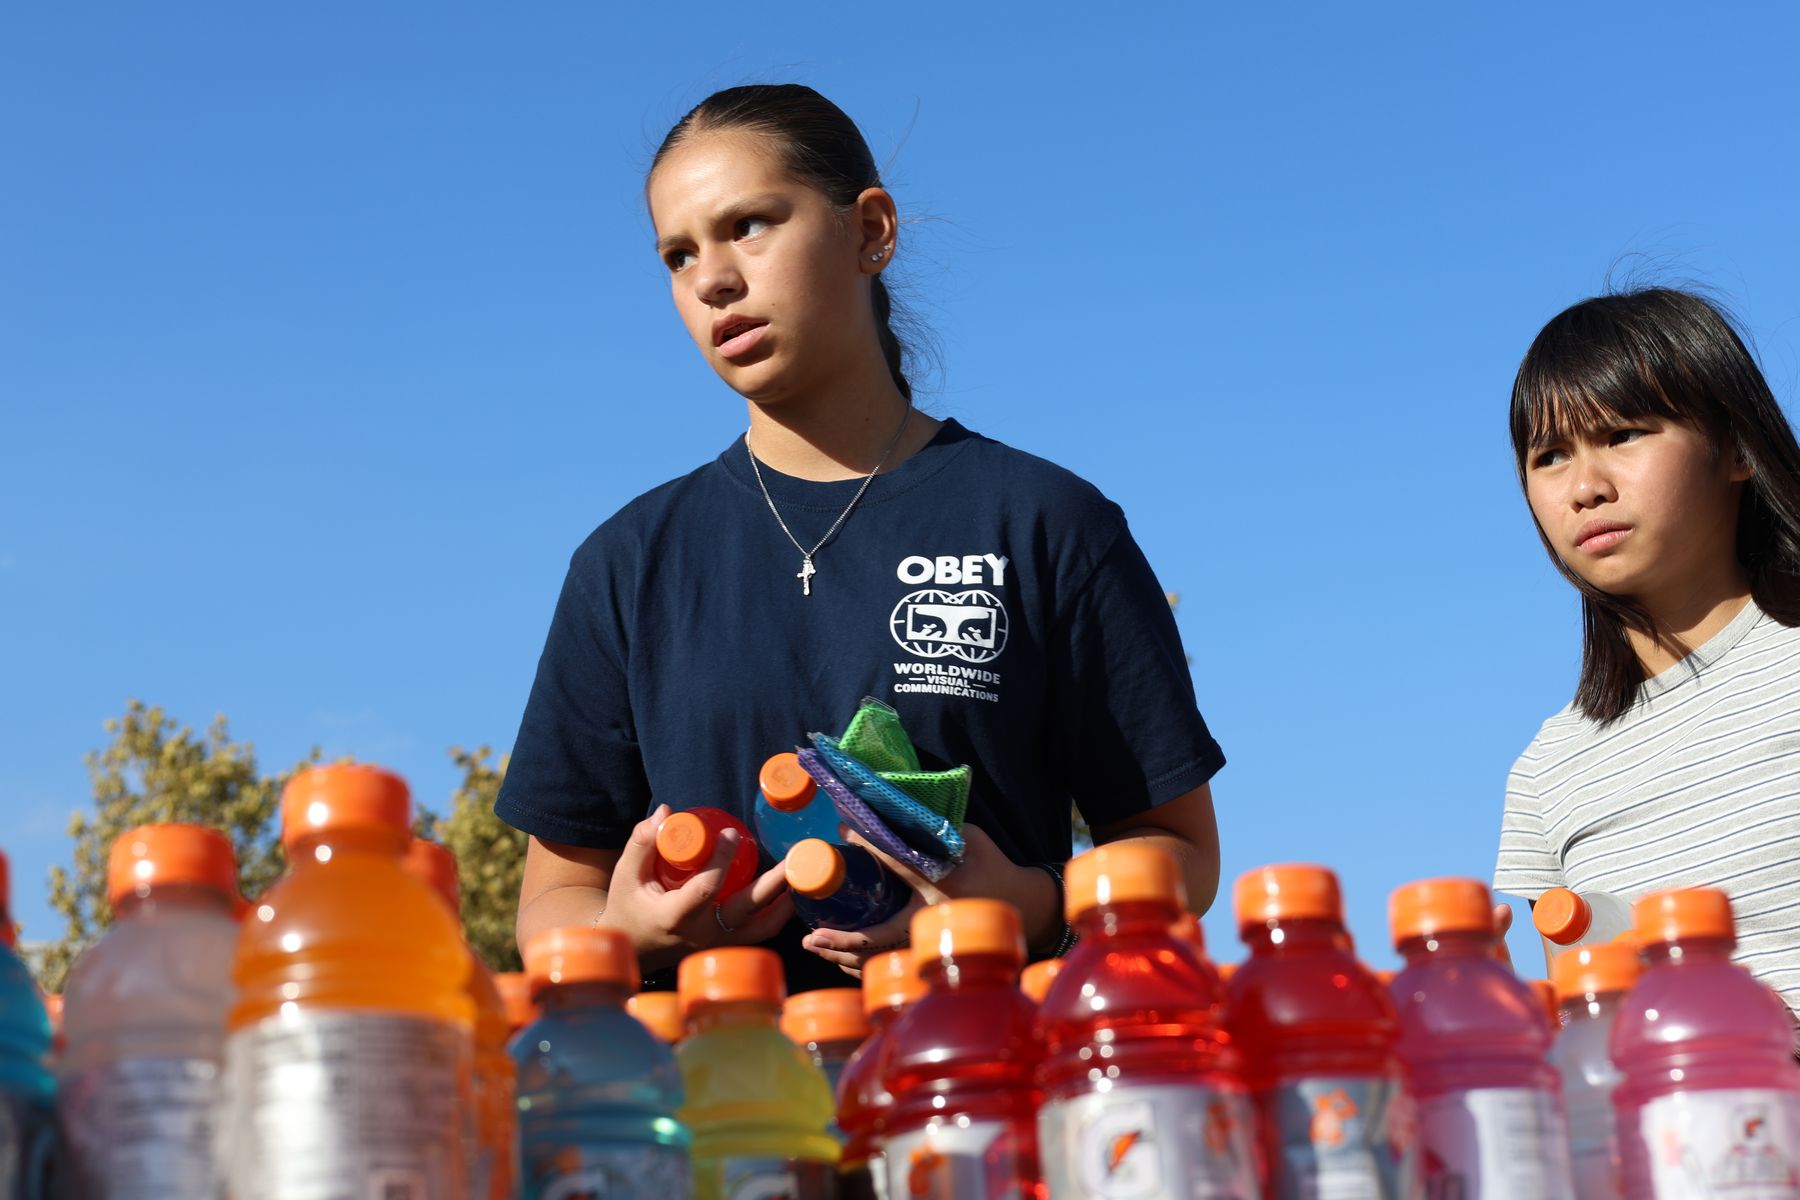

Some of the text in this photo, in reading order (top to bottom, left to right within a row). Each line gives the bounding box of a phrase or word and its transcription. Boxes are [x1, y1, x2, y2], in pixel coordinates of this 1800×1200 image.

[897, 553, 1009, 586] OBEY
[893, 663, 1000, 684] WORLDWIDE
[927, 675, 971, 688] VISUAL
[894, 683, 999, 703] COMMUNICATIONS
